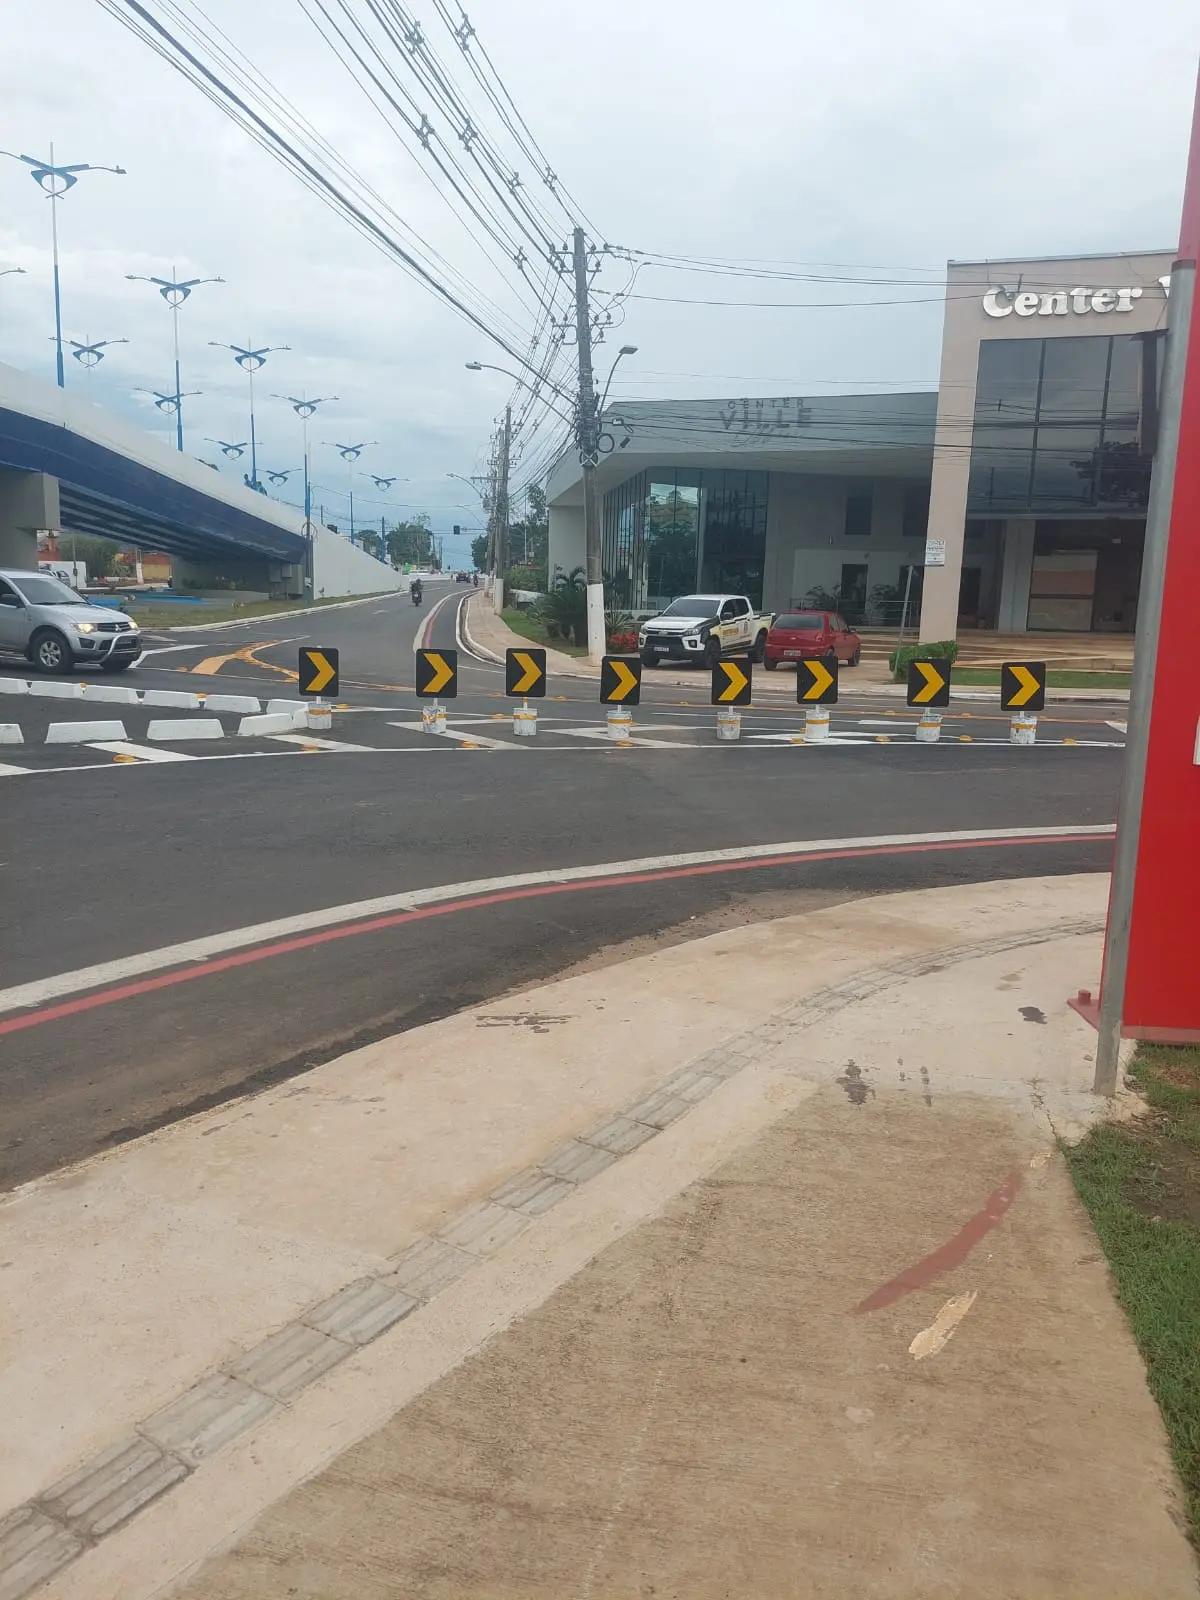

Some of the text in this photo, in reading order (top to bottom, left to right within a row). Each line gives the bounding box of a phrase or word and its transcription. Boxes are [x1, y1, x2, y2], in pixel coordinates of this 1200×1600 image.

[982, 284, 1143, 318] Center
[728, 398, 804, 409] CENTER
[718, 408, 812, 429] VILLE
